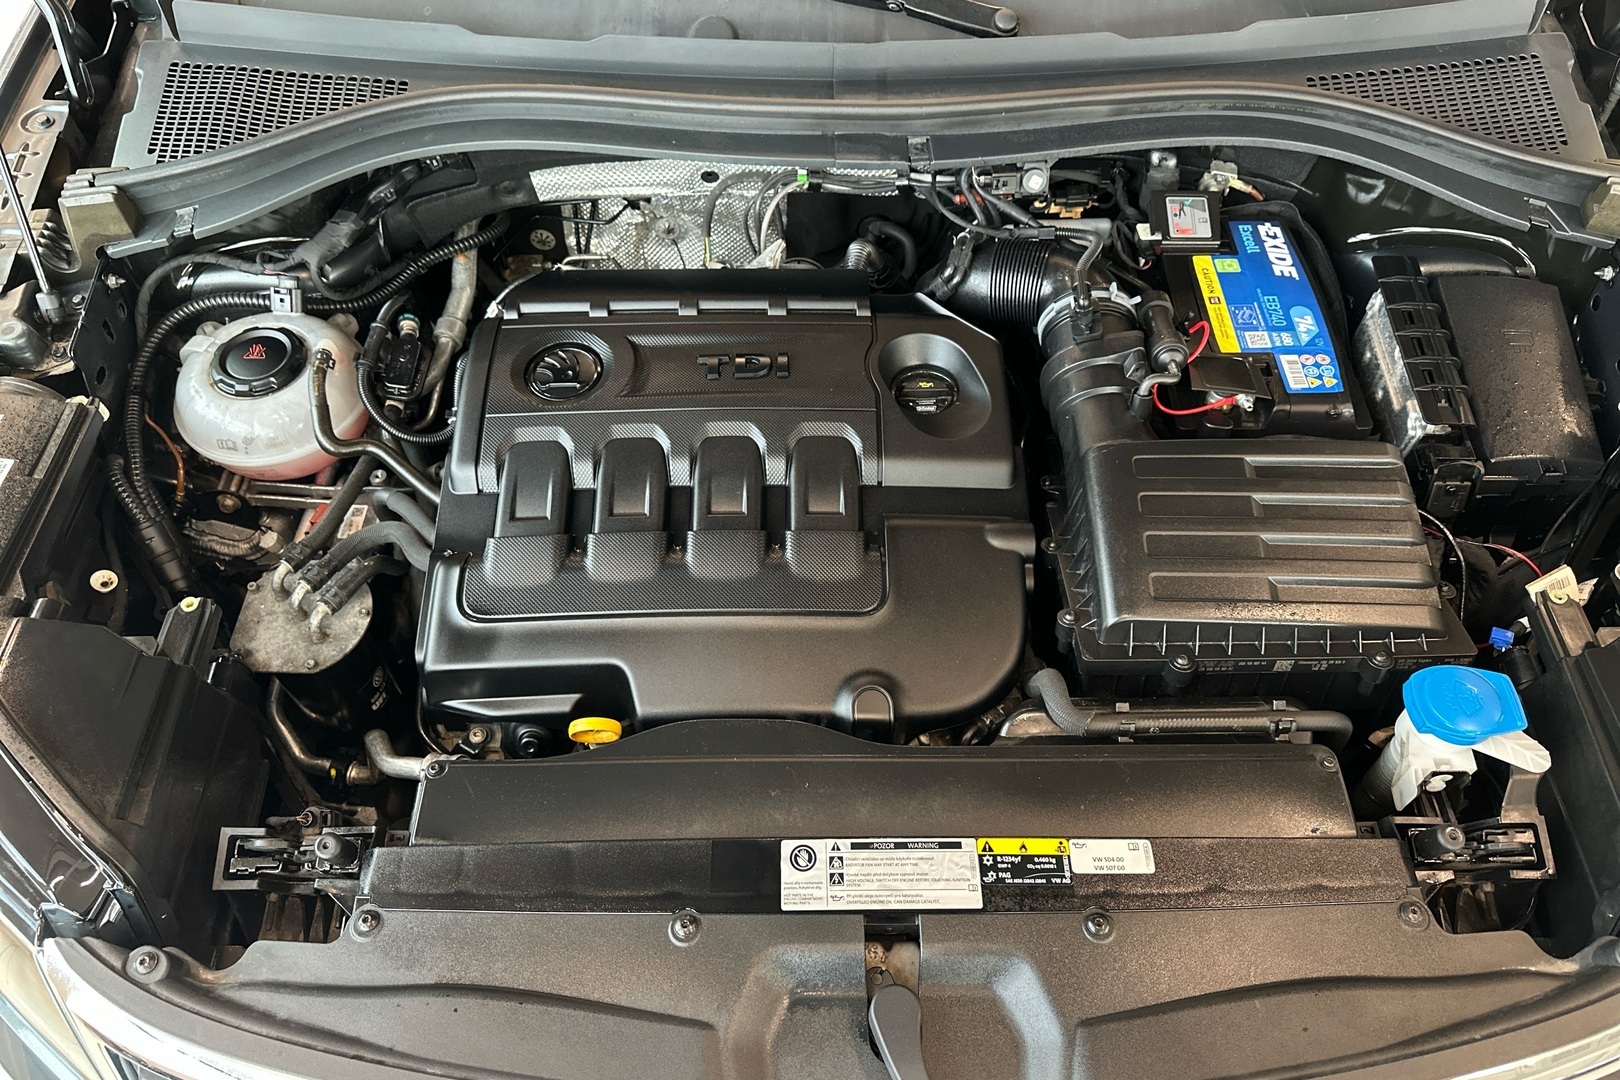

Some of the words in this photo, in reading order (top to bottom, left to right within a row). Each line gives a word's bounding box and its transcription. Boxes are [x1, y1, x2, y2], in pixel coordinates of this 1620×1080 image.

[1238, 224, 1261, 254] Excell
[1257, 222, 1300, 280] EXIDE
[1201, 267, 1216, 294] CAUTION
[1263, 295, 1287, 327] EB740
[1294, 315, 1316, 332] 74
[1280, 332, 1294, 346] 680
[1315, 337, 1325, 347] 12V
[696, 354, 790, 380] TDI
